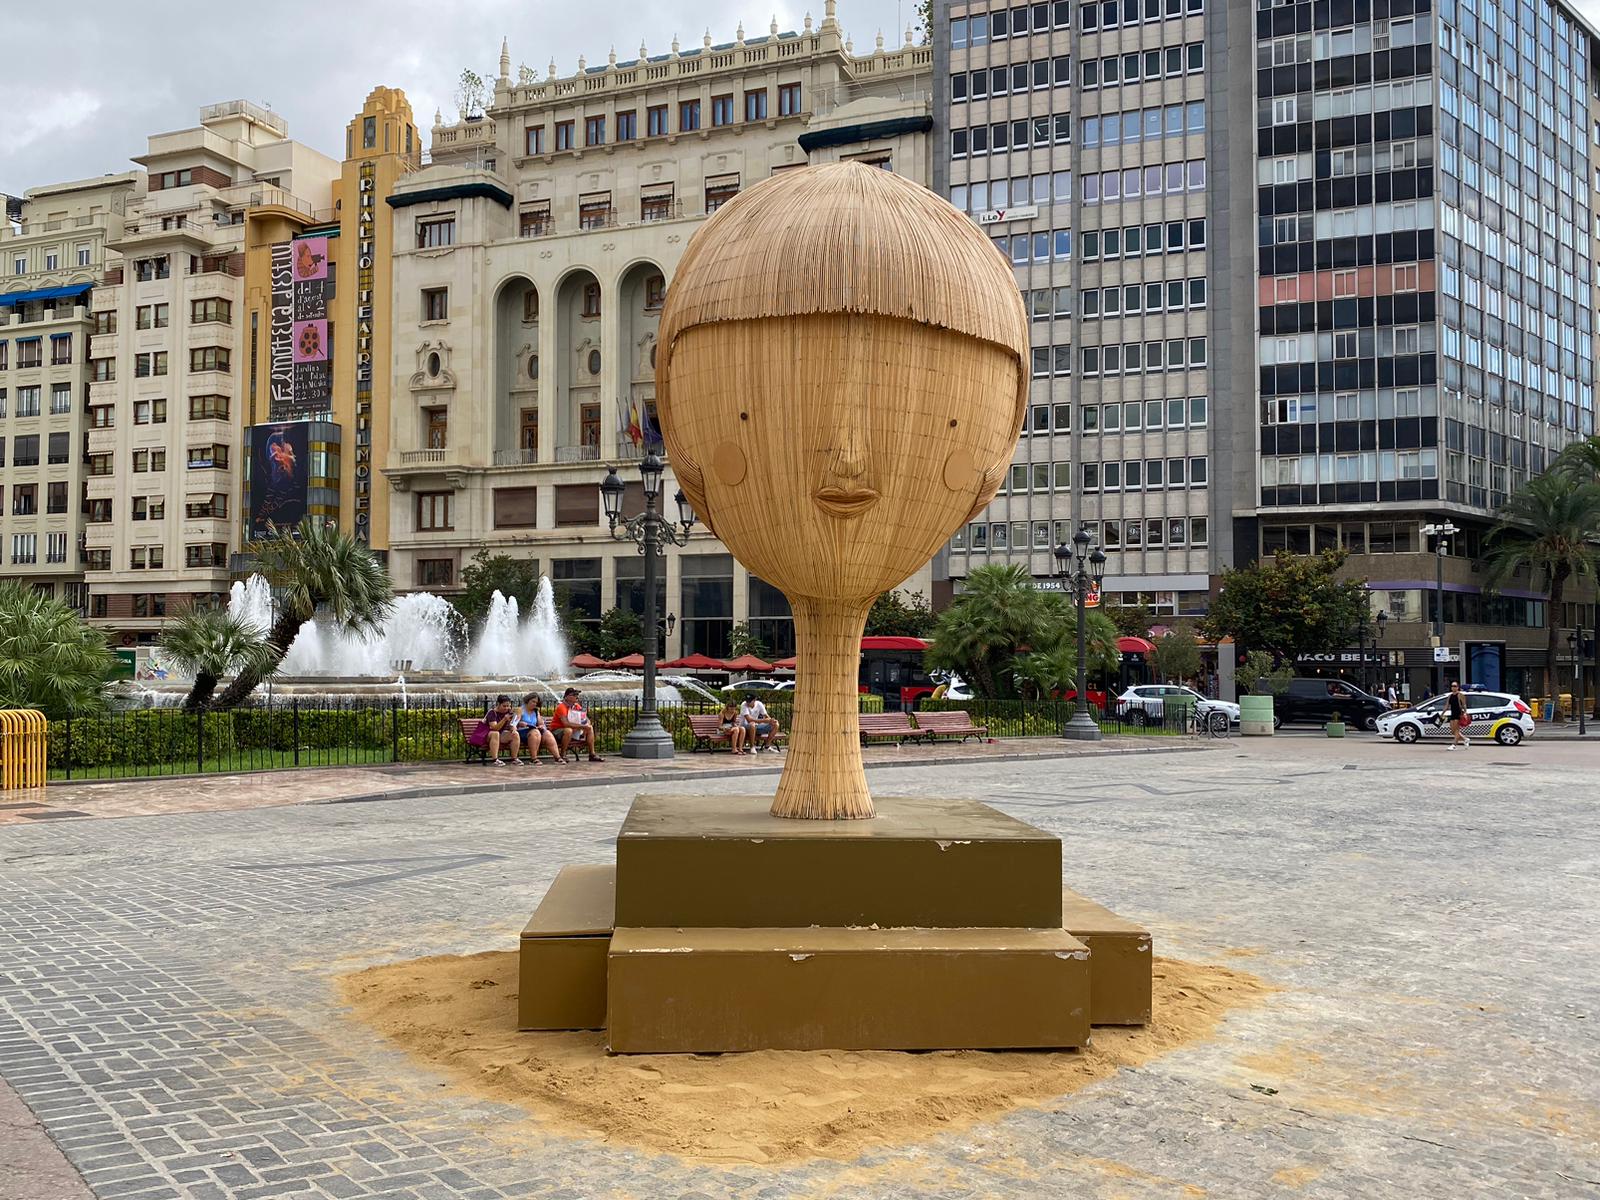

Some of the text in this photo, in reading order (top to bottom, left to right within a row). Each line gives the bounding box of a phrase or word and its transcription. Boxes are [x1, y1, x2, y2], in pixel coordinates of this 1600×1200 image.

[355, 178, 373, 542] RIALTO TEATRE FILMOTECA
[1340, 653, 1381, 662] BELL
[1087, 682, 1097, 690] C1
